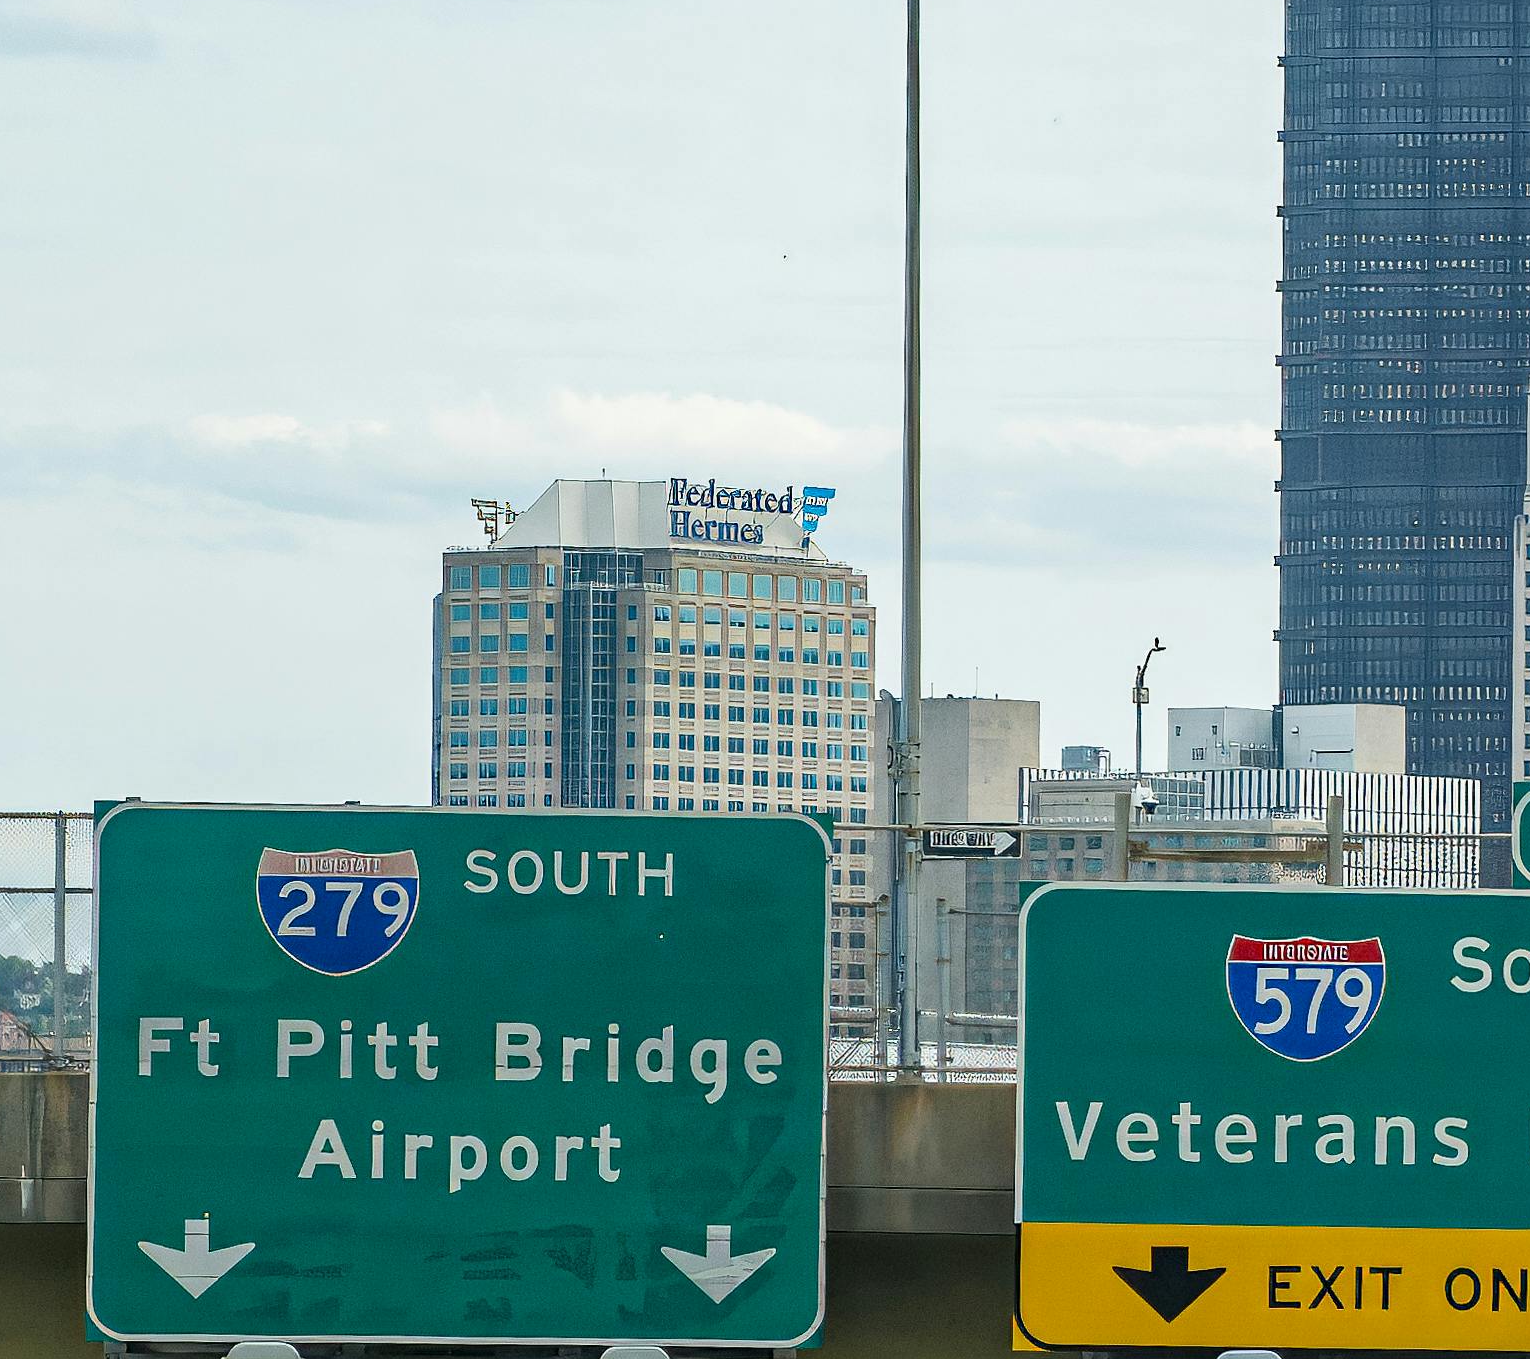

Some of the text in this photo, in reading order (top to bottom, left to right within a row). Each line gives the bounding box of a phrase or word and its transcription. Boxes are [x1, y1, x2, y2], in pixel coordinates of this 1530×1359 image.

[668, 478, 794, 514] Federated
[669, 510, 764, 544] Hermes
[464, 848, 674, 897] SOUTH
[277, 880, 410, 938] 279
[1253, 967, 1373, 1035] 579
[138, 1017, 783, 1104] Ft Pitt Bridge
[297, 1119, 623, 1194] Airport
[1055, 1100, 1471, 1168] Veterans
[1268, 1265, 1403, 1312] EXIT
